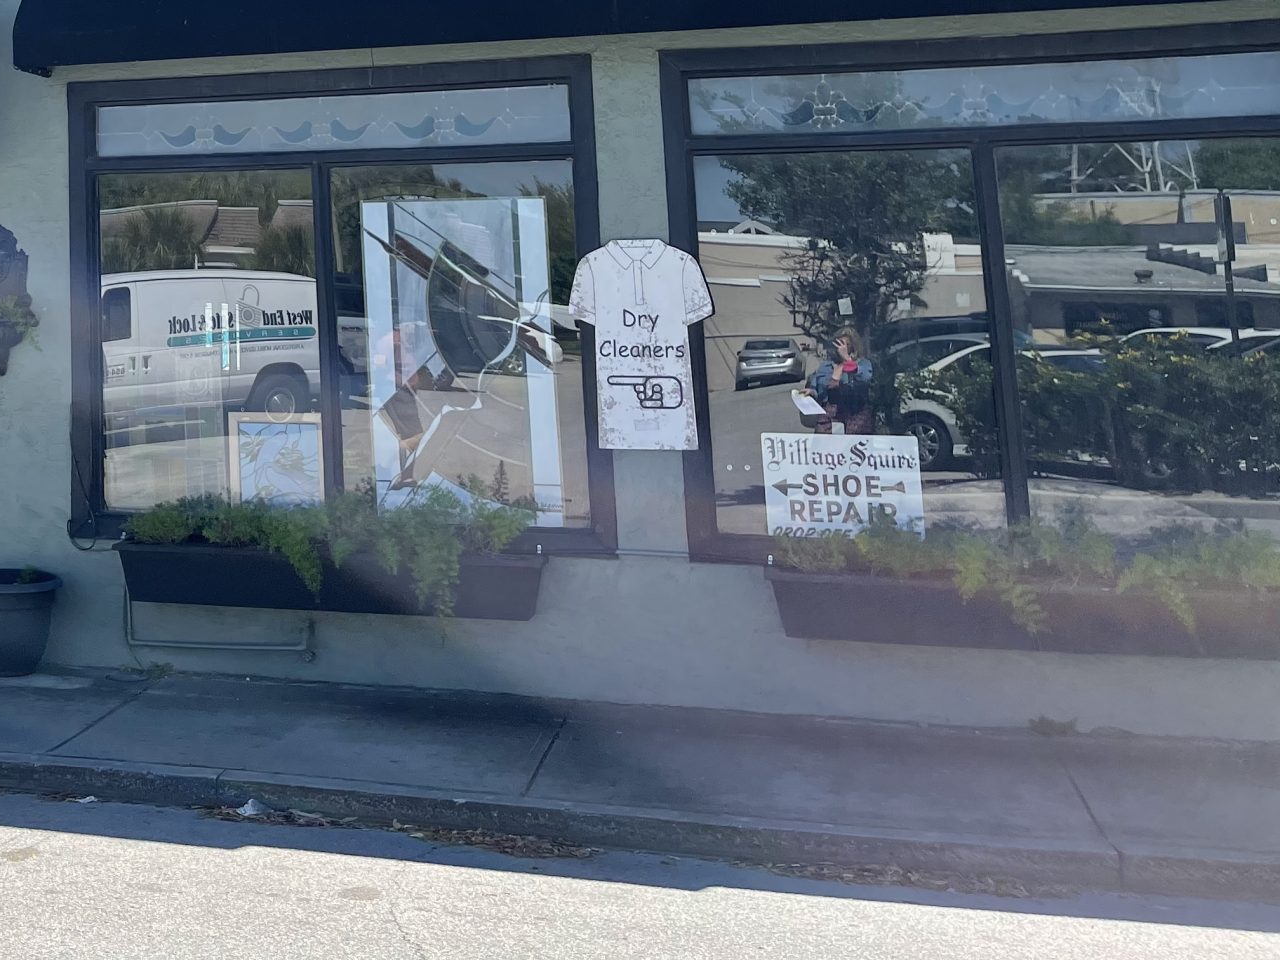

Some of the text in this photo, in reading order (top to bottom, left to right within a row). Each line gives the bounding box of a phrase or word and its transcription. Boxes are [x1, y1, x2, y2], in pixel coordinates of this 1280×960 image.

[622, 309, 660, 332] Dry
[599, 340, 685, 358] Cleaners
[763, 437, 918, 473] Village Squire
[802, 473, 883, 498] SHOE
[789, 499, 898, 526] REPAIR
